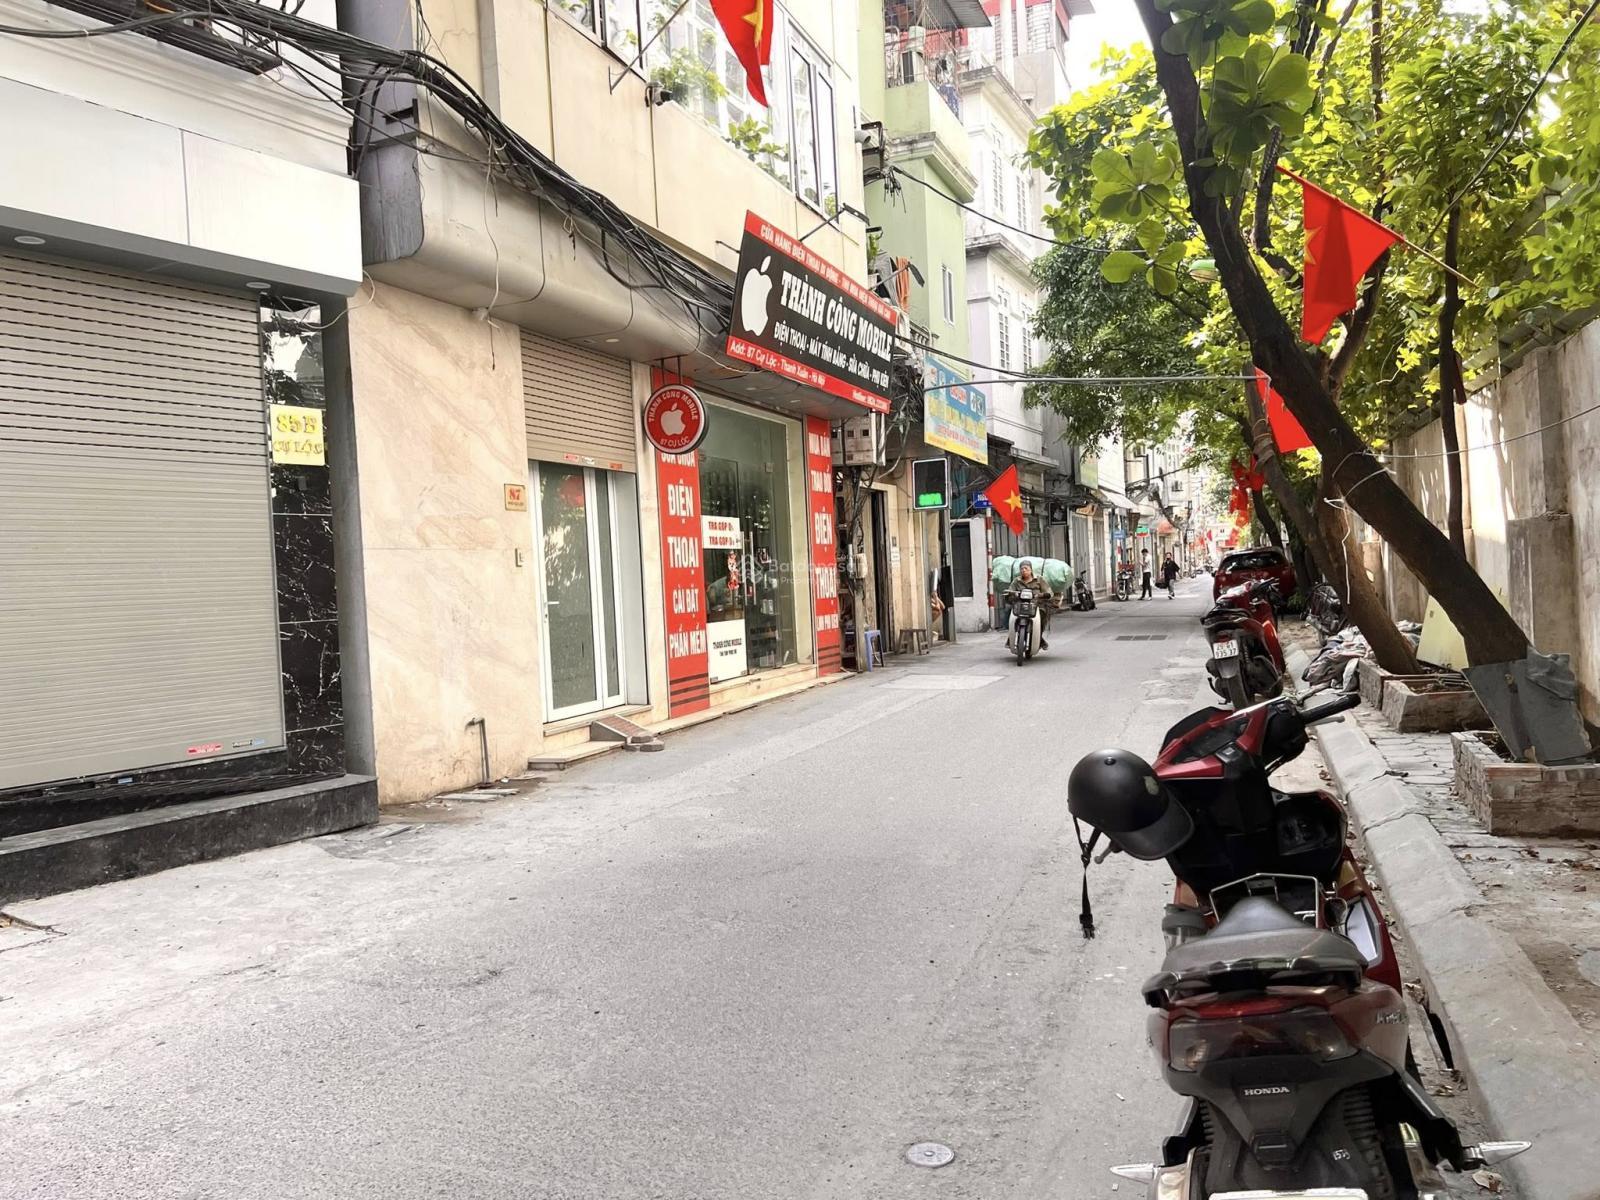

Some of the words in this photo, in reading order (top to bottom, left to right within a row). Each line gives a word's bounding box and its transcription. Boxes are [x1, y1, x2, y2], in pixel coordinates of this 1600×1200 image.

[781, 270, 827, 326] THÀNH
[826, 296, 858, 342] CÔNG
[856, 317, 893, 362] MOBILE
[746, 346, 756, 359] 87
[774, 320, 790, 347] ĐIỆN
[789, 328, 808, 355] THOẠI
[808, 336, 823, 358] MÁY
[821, 341, 834, 363] TÍNH
[832, 346, 847, 369] BẢNG
[667, 478, 694, 524] ĐIỆN
[814, 506, 833, 553] ĐIỆN
[667, 536, 700, 575] THOẠI
[673, 583, 686, 615] CÀI
[685, 583, 699, 618] ĐẶT
[815, 567, 838, 606] THOẠI
[669, 623, 690, 658] PHẦN
[690, 622, 707, 655] MỀM
[1244, 1086, 1290, 1096] HONDA
